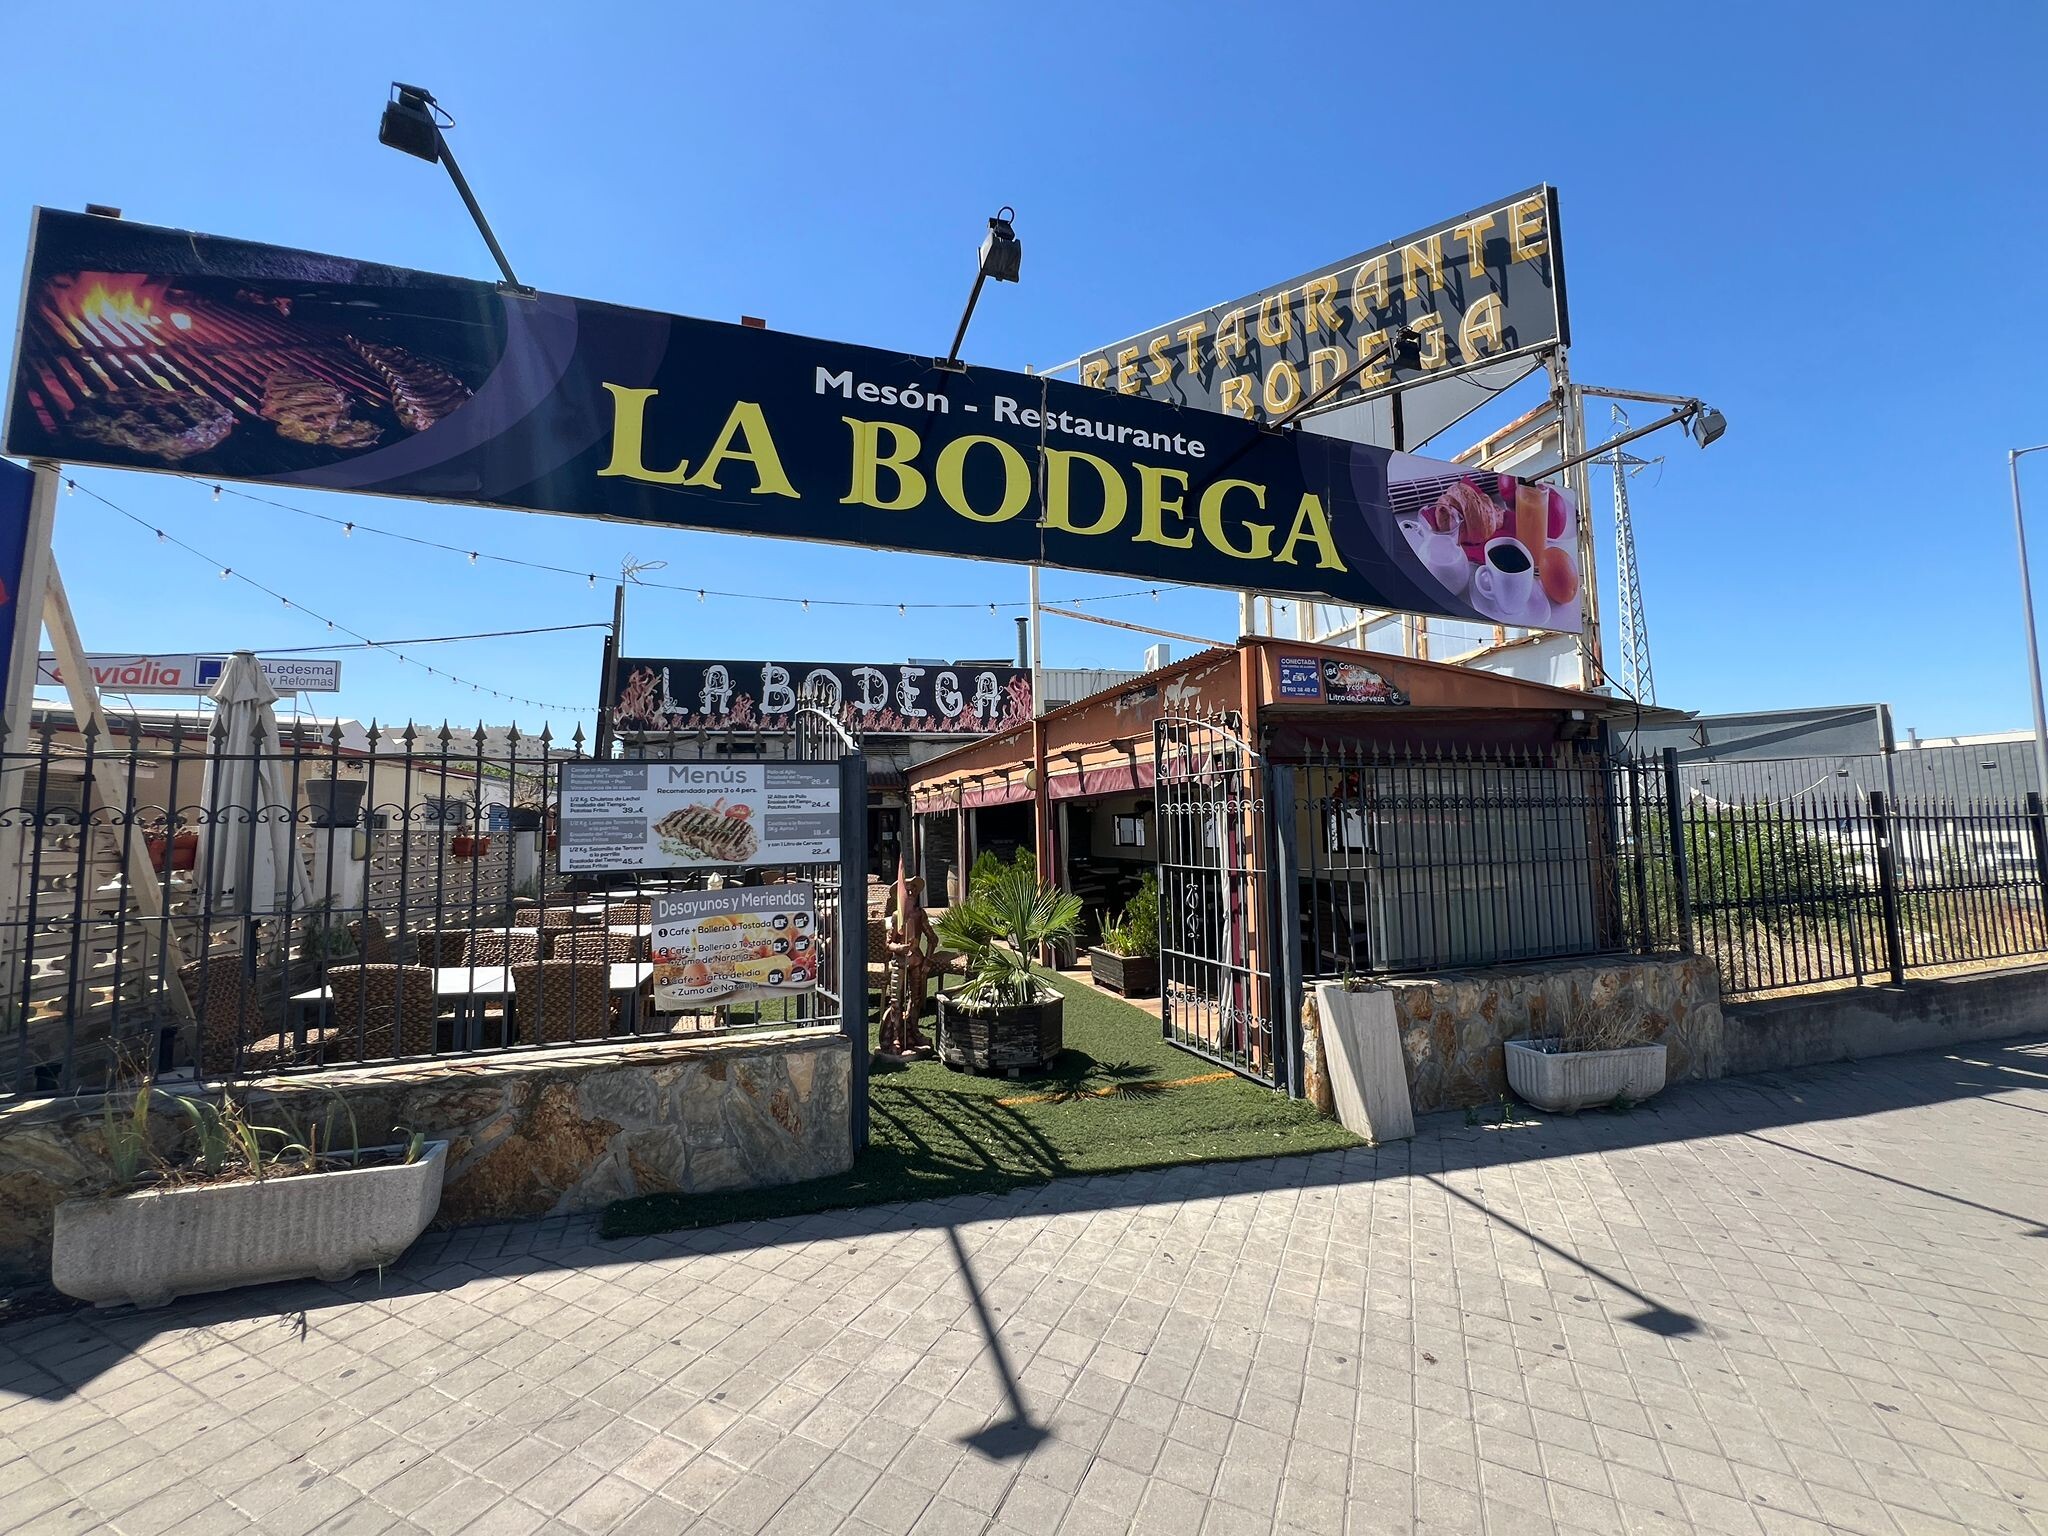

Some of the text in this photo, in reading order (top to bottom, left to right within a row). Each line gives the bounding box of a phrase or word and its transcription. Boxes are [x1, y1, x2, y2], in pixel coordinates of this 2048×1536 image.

[1082, 194, 1550, 391] RESTAURANTE
[1219, 293, 1503, 421] BODEGA
[815, 366, 951, 414] Mesón
[993, 394, 1207, 460] Restaurante
[597, 381, 1349, 572] LA BODEGA
[269, 675, 334, 687] y Reformas
[661, 662, 1005, 718] LA BODEGA
[1329, 693, 1346, 701] Litro
[1356, 694, 1385, 702] Cerveza
[668, 765, 747, 784] Menús
[659, 891, 806, 918] Desayunos y Meriendas
[669, 927, 690, 937] Café
[738, 920, 772, 930] Tostada
[669, 946, 690, 956] Café
[739, 938, 772, 949] Tostada
[702, 957, 713, 965] de
[715, 952, 749, 963] Naranja
[703, 972, 730, 981] Tarta
[731, 969, 746, 979] del
[678, 987, 705, 997] Zumo
[707, 985, 719, 994] de
